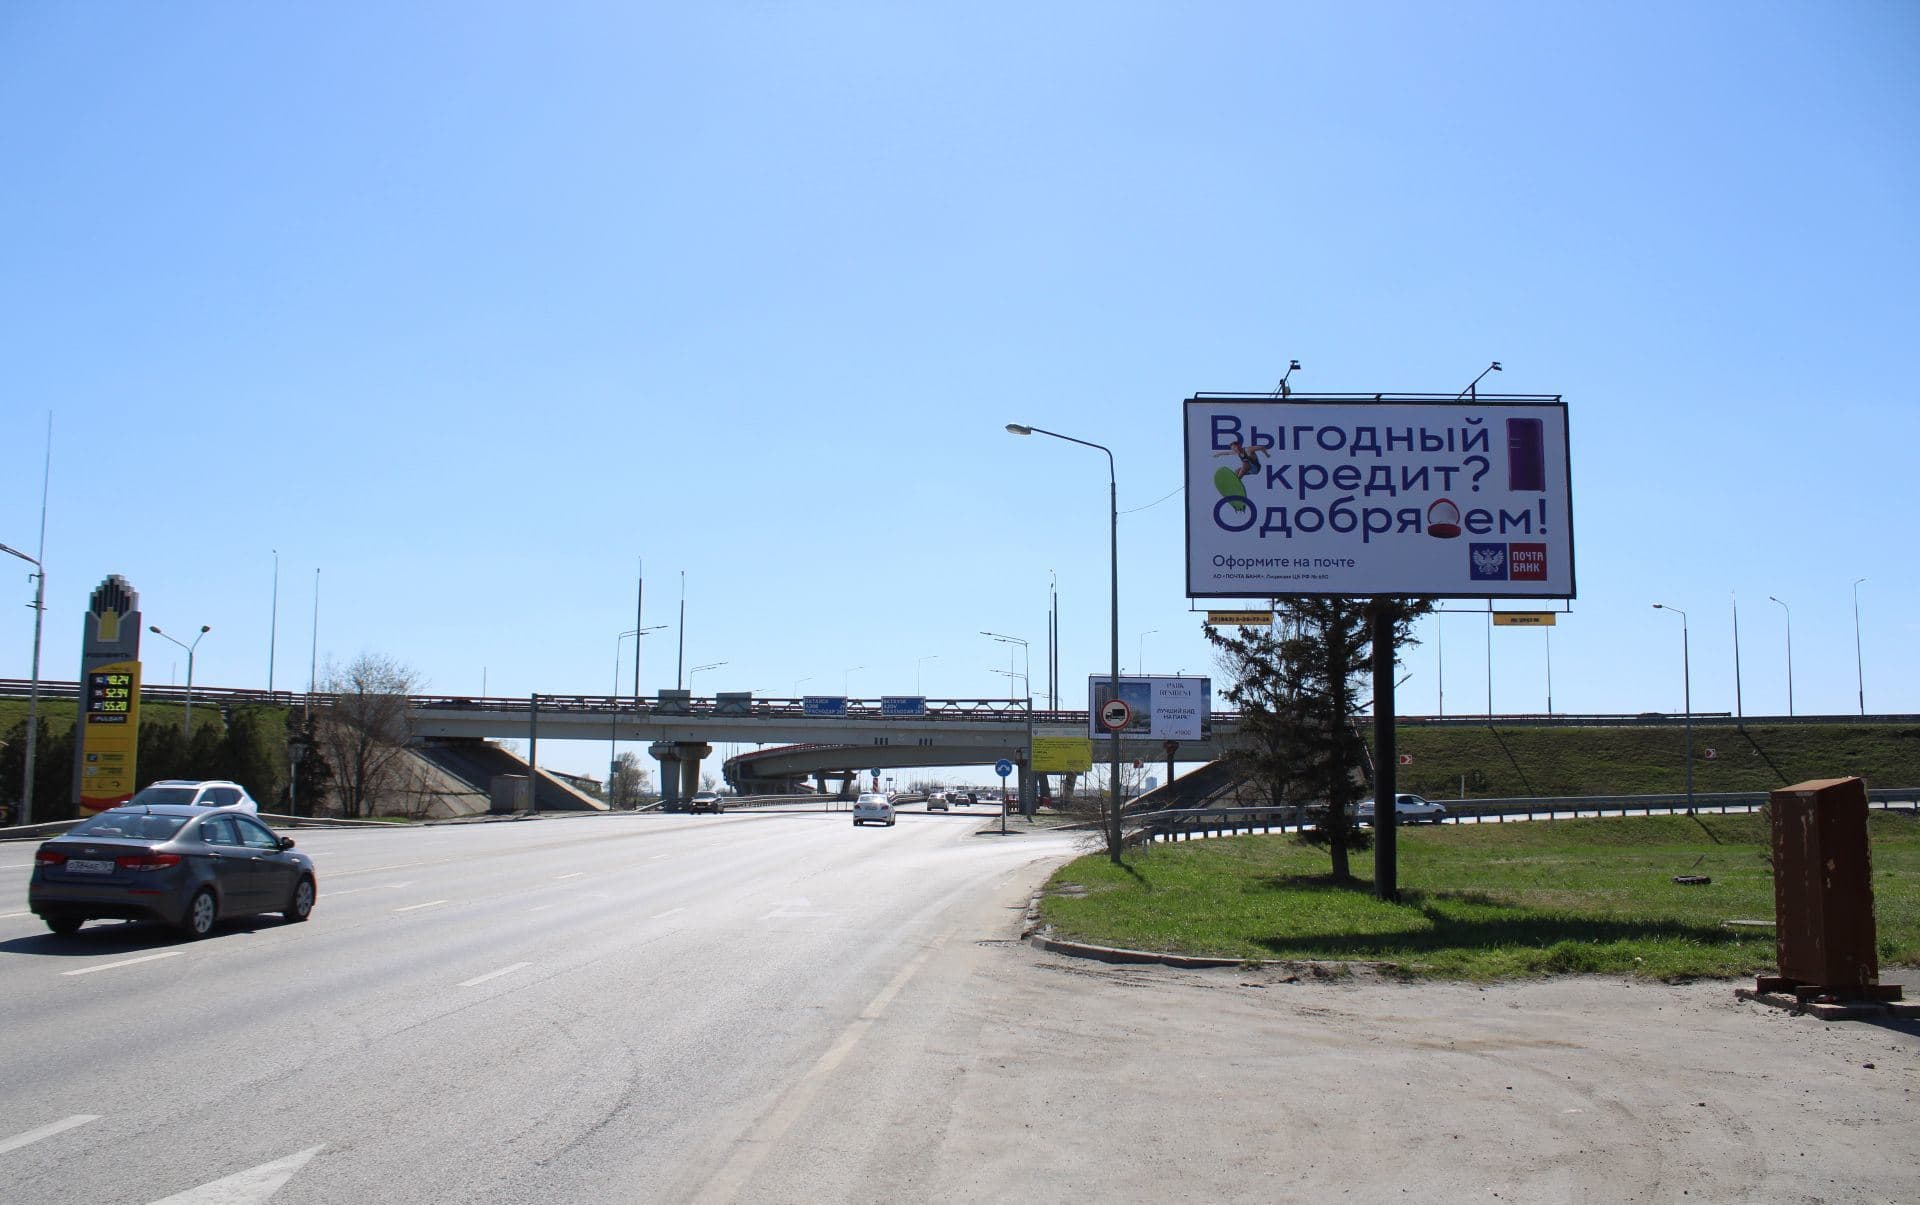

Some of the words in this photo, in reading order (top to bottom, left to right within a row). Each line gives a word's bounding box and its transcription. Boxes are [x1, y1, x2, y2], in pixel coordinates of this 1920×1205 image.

[1211, 415, 1490, 457] Выгодный
[1266, 455, 1490, 501] кредит?
[1212, 554, 1290, 570] Оформите
[1293, 558, 1310, 568] на
[1313, 558, 1355, 568] почте
[1512, 551, 1544, 561] ПОЧТА
[1513, 562, 1540, 573] БАНК
